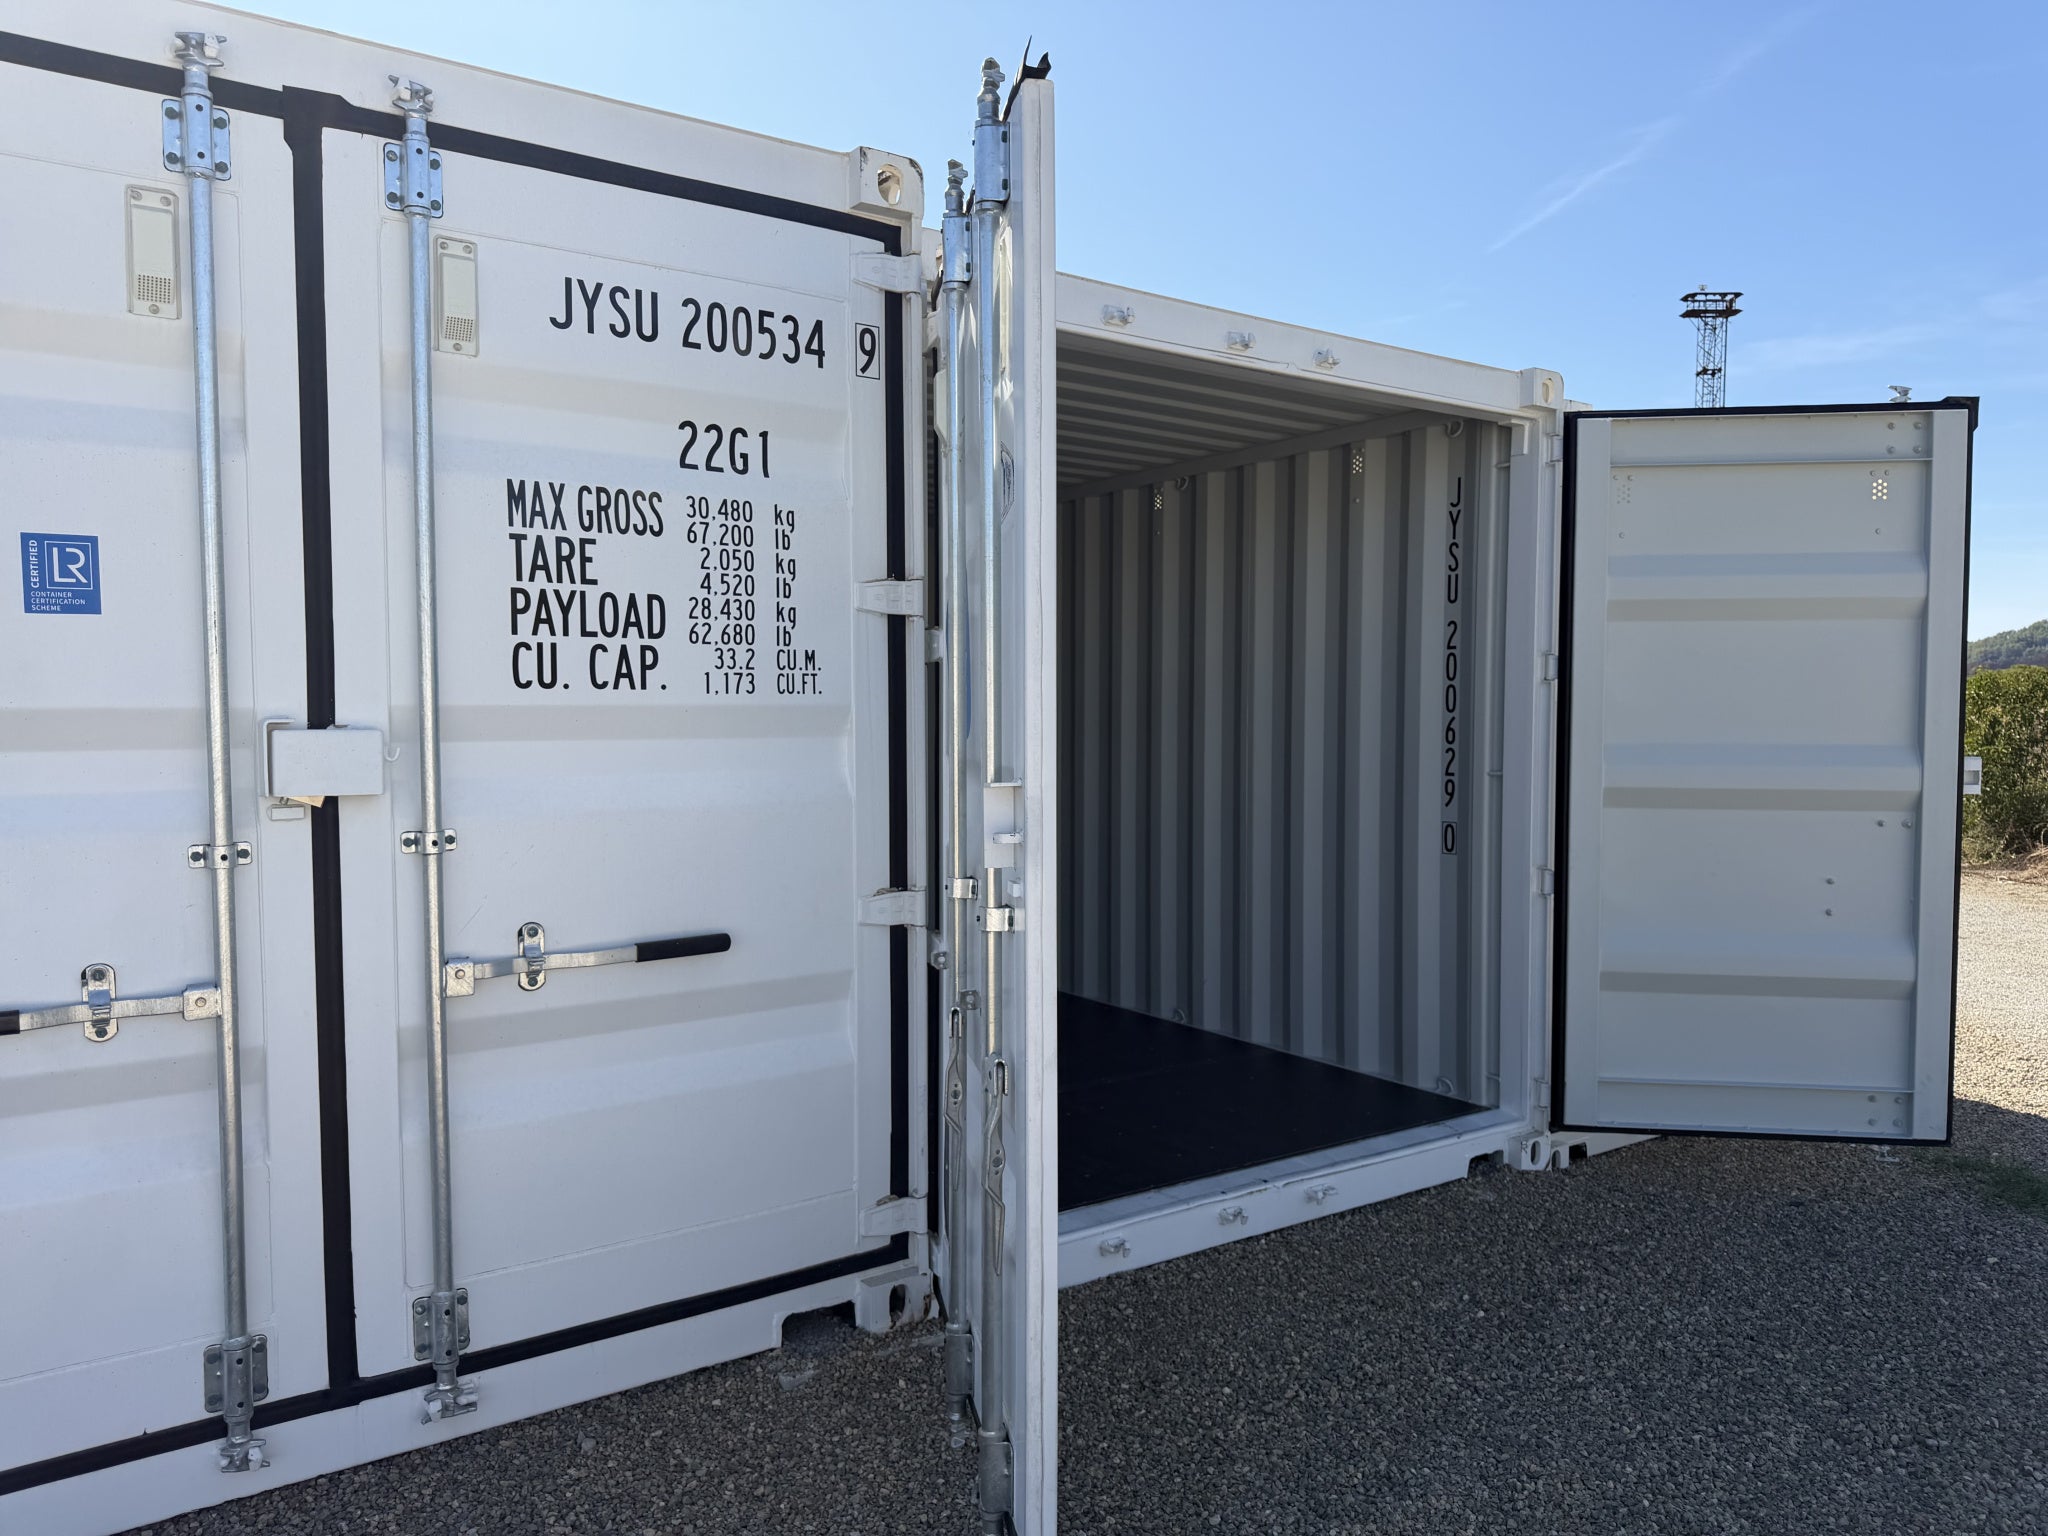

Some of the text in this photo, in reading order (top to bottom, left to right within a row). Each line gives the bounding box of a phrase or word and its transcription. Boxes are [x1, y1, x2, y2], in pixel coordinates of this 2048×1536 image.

[549, 276, 877, 375] JYSU 200534 9
[678, 420, 770, 479] 22G1
[506, 478, 795, 538] MAX GROSS 30,480 kg
[508, 532, 796, 586] TARE 2,050 kg
[686, 521, 791, 551] 67,200 lb
[29, 539, 40, 589] CERTIFIED
[52, 546, 88, 583] LR
[700, 572, 792, 599] 4,520 lb
[30, 590, 73, 598] CONTAINER
[31, 604, 62, 612] SCHEME
[510, 586, 797, 640] PAYLOAD 28,430 kg
[688, 622, 792, 647] 62,680 lb
[512, 641, 822, 691] CU. CAP. 33.2 CU.M.
[703, 671, 822, 696] 1,173 CU.FT.
[1443, 476, 1462, 853] JYSU 200629 0
